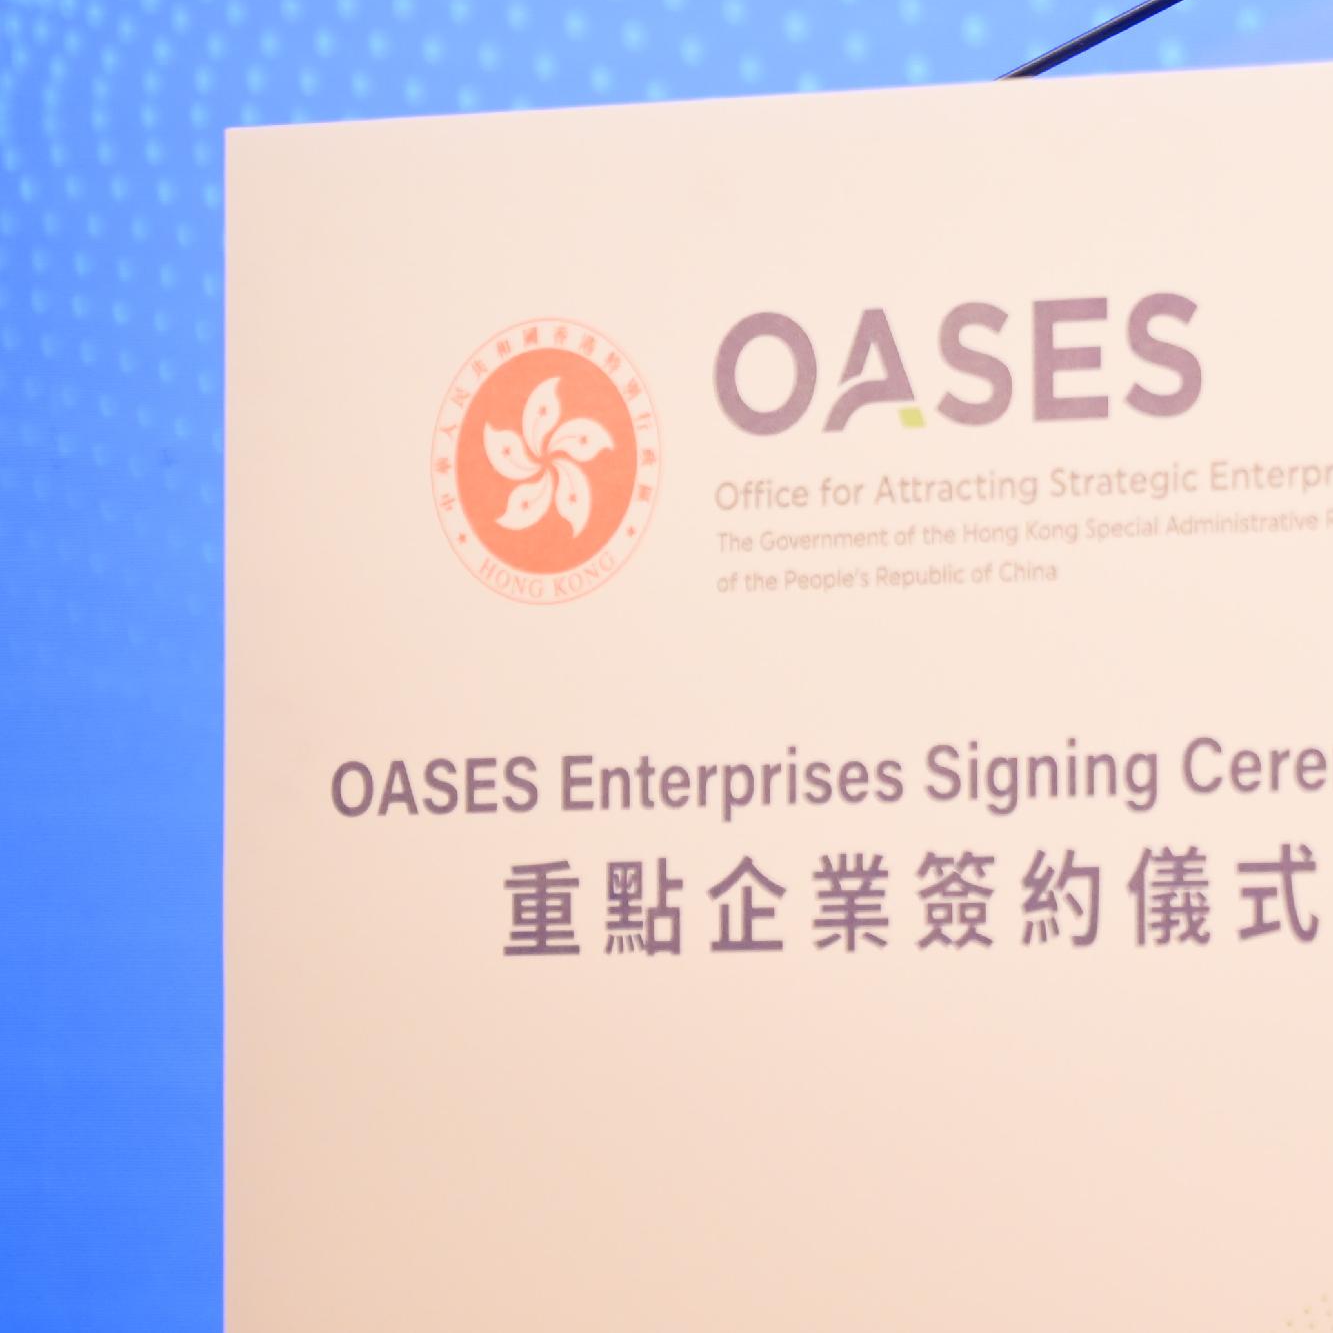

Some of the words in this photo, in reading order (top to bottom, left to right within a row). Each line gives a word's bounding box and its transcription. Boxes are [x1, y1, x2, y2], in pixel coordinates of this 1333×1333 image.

[715, 293, 1201, 435] OASES
[715, 479, 809, 511] Office
[819, 477, 864, 506] for
[875, 471, 1038, 505] Attracting
[1050, 463, 1197, 500] Strategic
[717, 531, 754, 552] The
[759, 529, 888, 552] Government
[894, 525, 916, 546] of
[922, 525, 956, 545] the
[963, 523, 1020, 546] Hong
[1026, 521, 1079, 544] Kong
[1086, 517, 1159, 541] Special
[1166, 512, 1319, 535] Administrative
[479, 557, 544, 599] HONG
[553, 551, 616, 598] KONG
[717, 573, 740, 593] of
[745, 571, 779, 592] the
[784, 568, 870, 592] People's
[876, 564, 964, 588] Republic
[971, 562, 993, 584] of
[999, 560, 1058, 583] China
[331, 756, 539, 817] OASES
[562, 746, 904, 823] Enterprises
[925, 738, 1158, 816] Signing
[503, 843, 1319, 956] 重點企業簽約儀式
